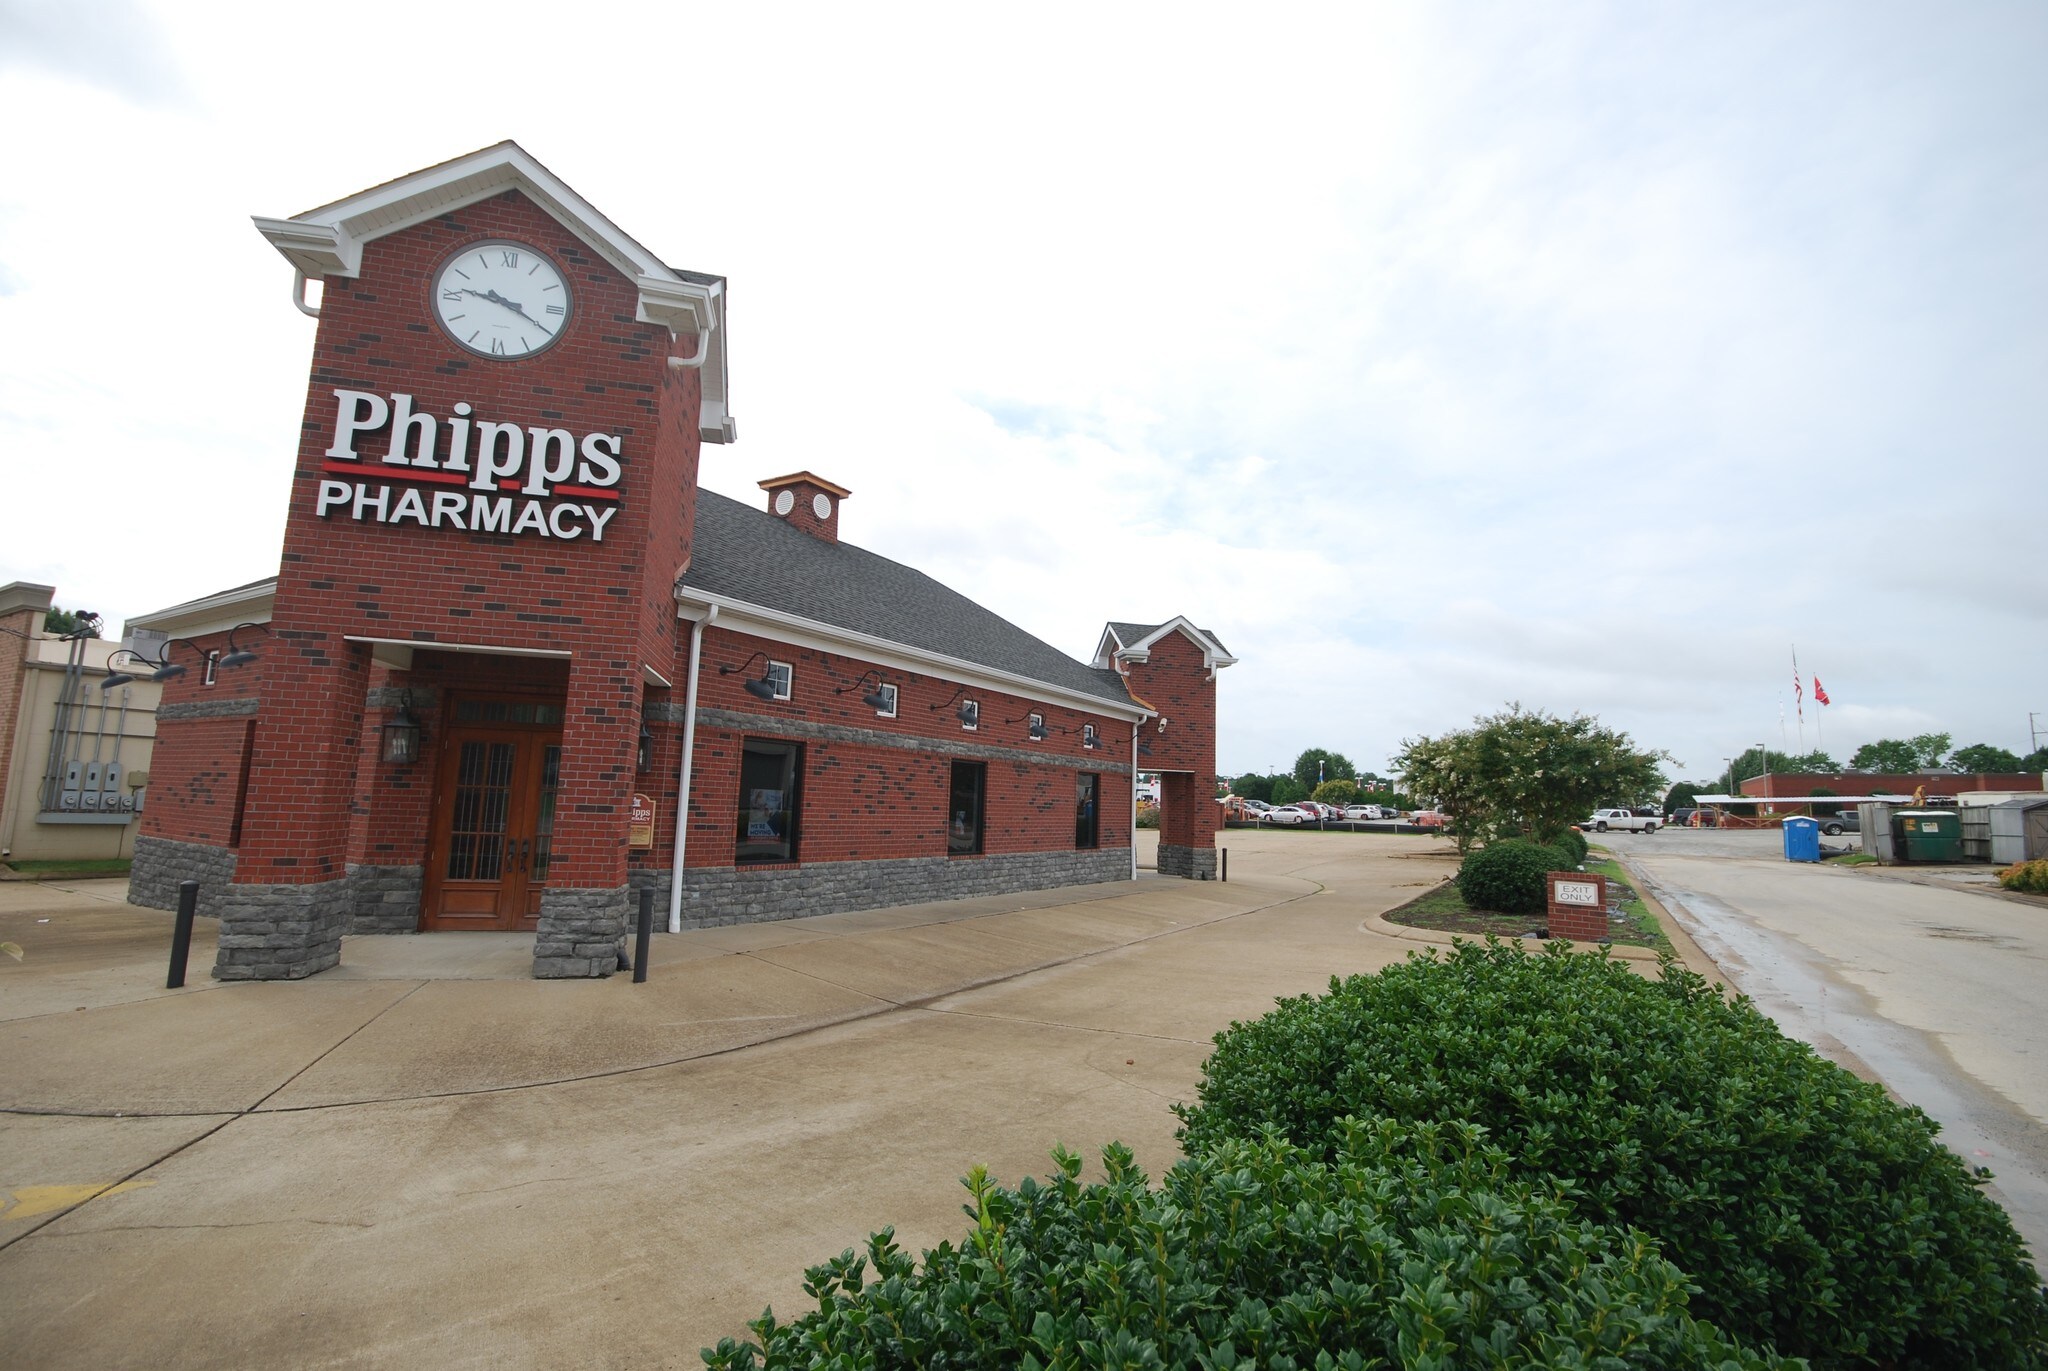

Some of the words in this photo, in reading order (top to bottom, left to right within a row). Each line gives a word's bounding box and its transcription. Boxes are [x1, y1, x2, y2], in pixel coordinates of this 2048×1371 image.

[325, 388, 622, 497] Phipps
[316, 480, 618, 542] PHARMACY
[632, 808, 650, 817] ipps
[1563, 885, 1590, 893] EXIT
[1560, 893, 1592, 901] ONLY
